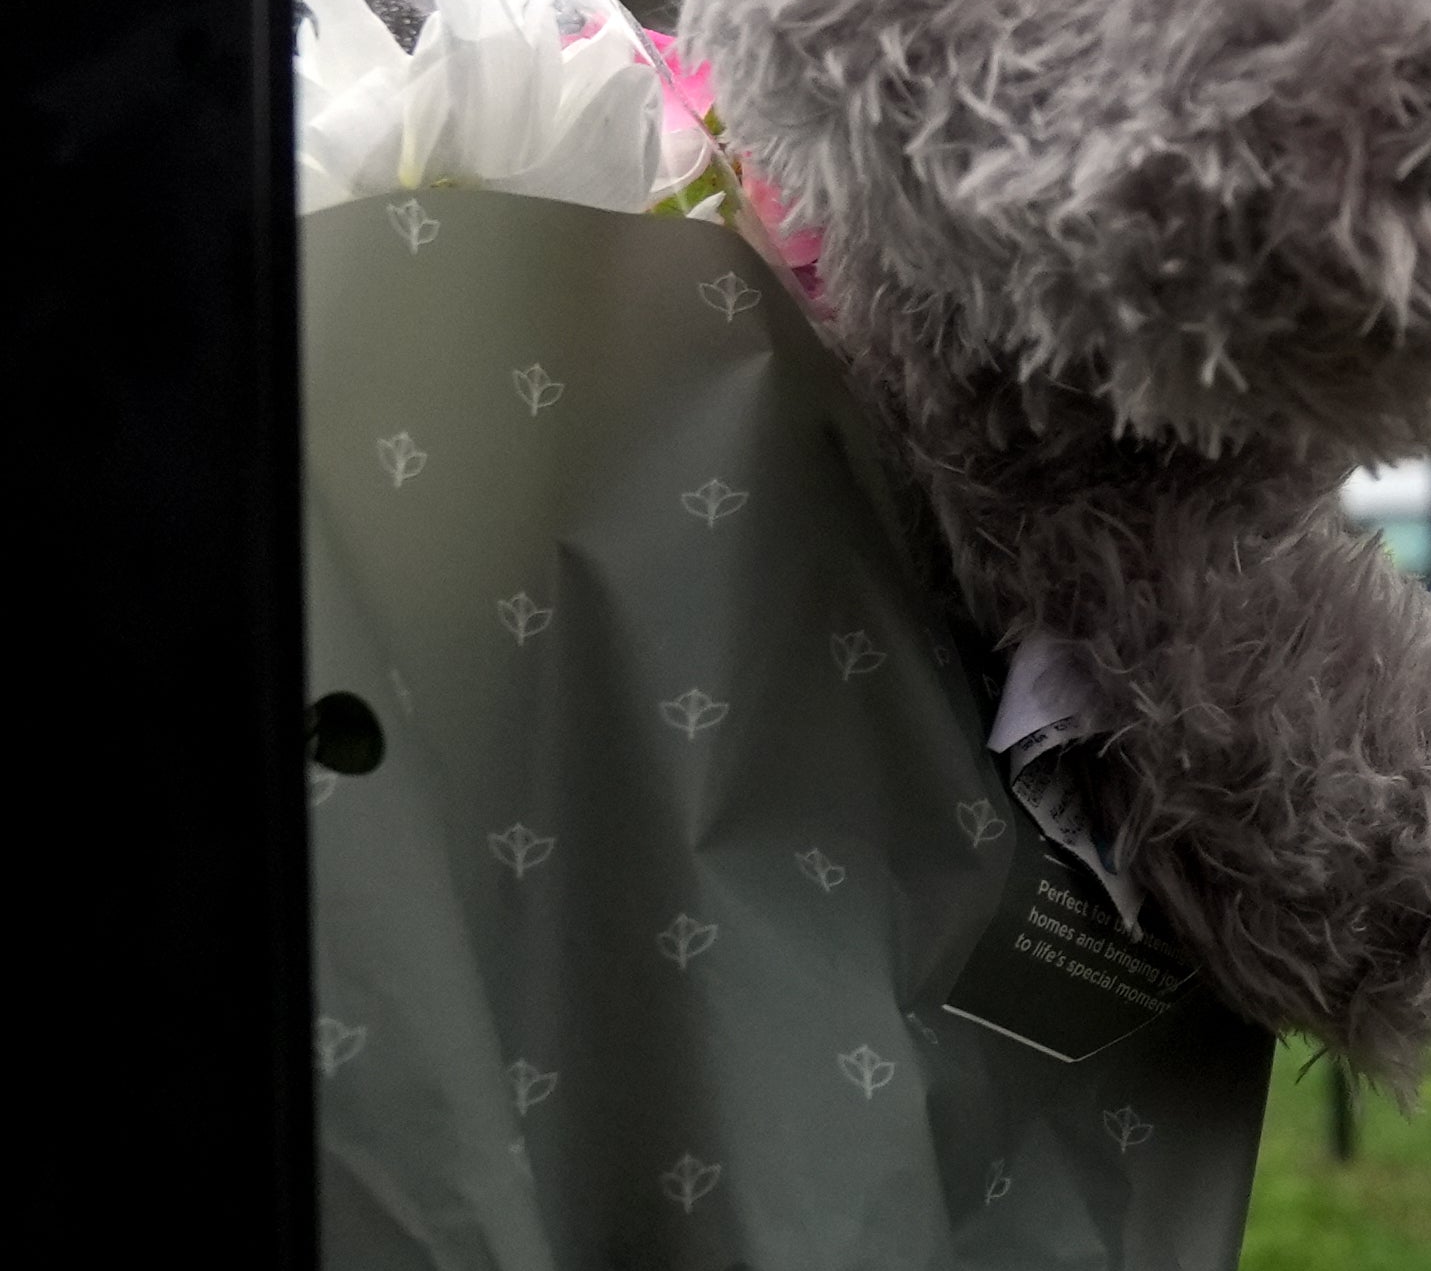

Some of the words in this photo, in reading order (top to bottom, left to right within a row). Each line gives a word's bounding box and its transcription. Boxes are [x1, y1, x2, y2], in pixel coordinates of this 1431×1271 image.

[1037, 879, 1089, 918] Perfect
[1091, 905, 1111, 927] for
[1014, 931, 1033, 953] to
[1032, 941, 1067, 970] life's
[1066, 958, 1118, 994] special
[1028, 905, 1075, 942] homes
[1076, 931, 1102, 955] and
[1104, 942, 1160, 984] bringing
